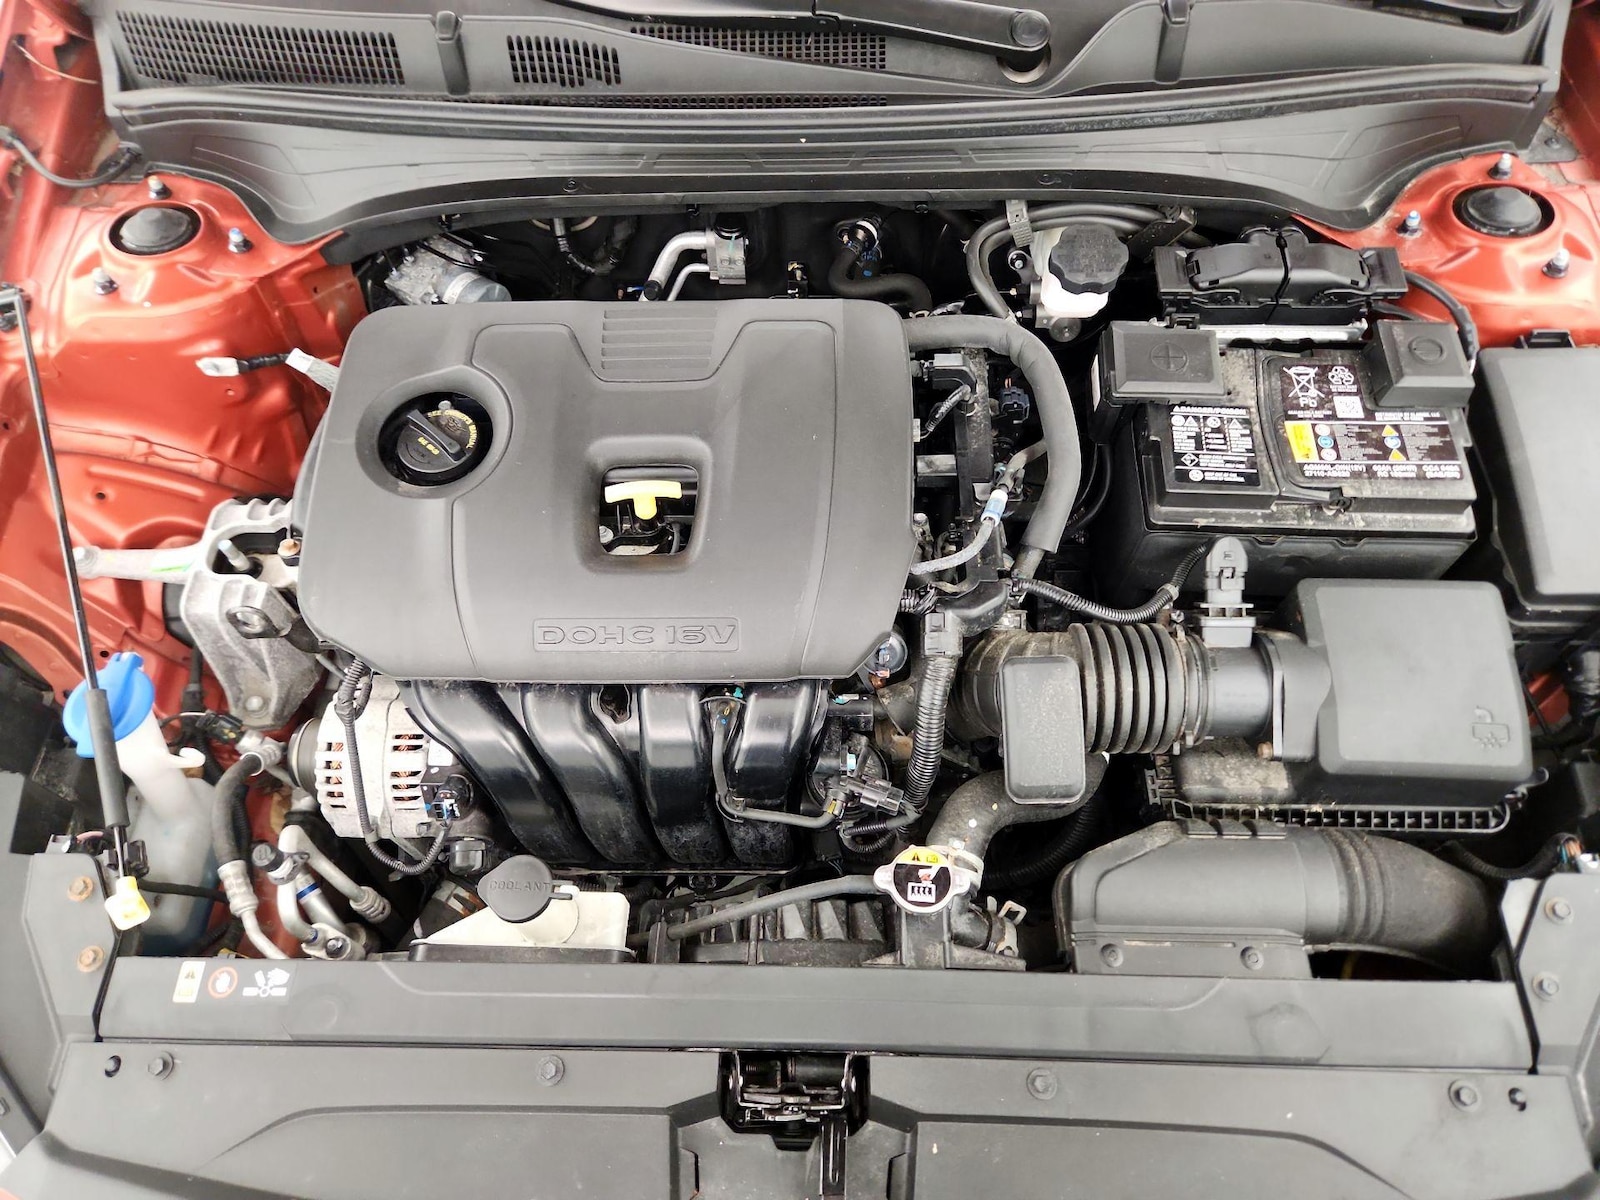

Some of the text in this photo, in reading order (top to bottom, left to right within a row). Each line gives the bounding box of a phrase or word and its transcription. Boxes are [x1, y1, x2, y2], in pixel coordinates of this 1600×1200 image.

[1299, 397, 1317, 407] Pb
[427, 409, 441, 418] SEE
[537, 624, 736, 645] DOHC 16V
[489, 880, 551, 892] COOLANT
